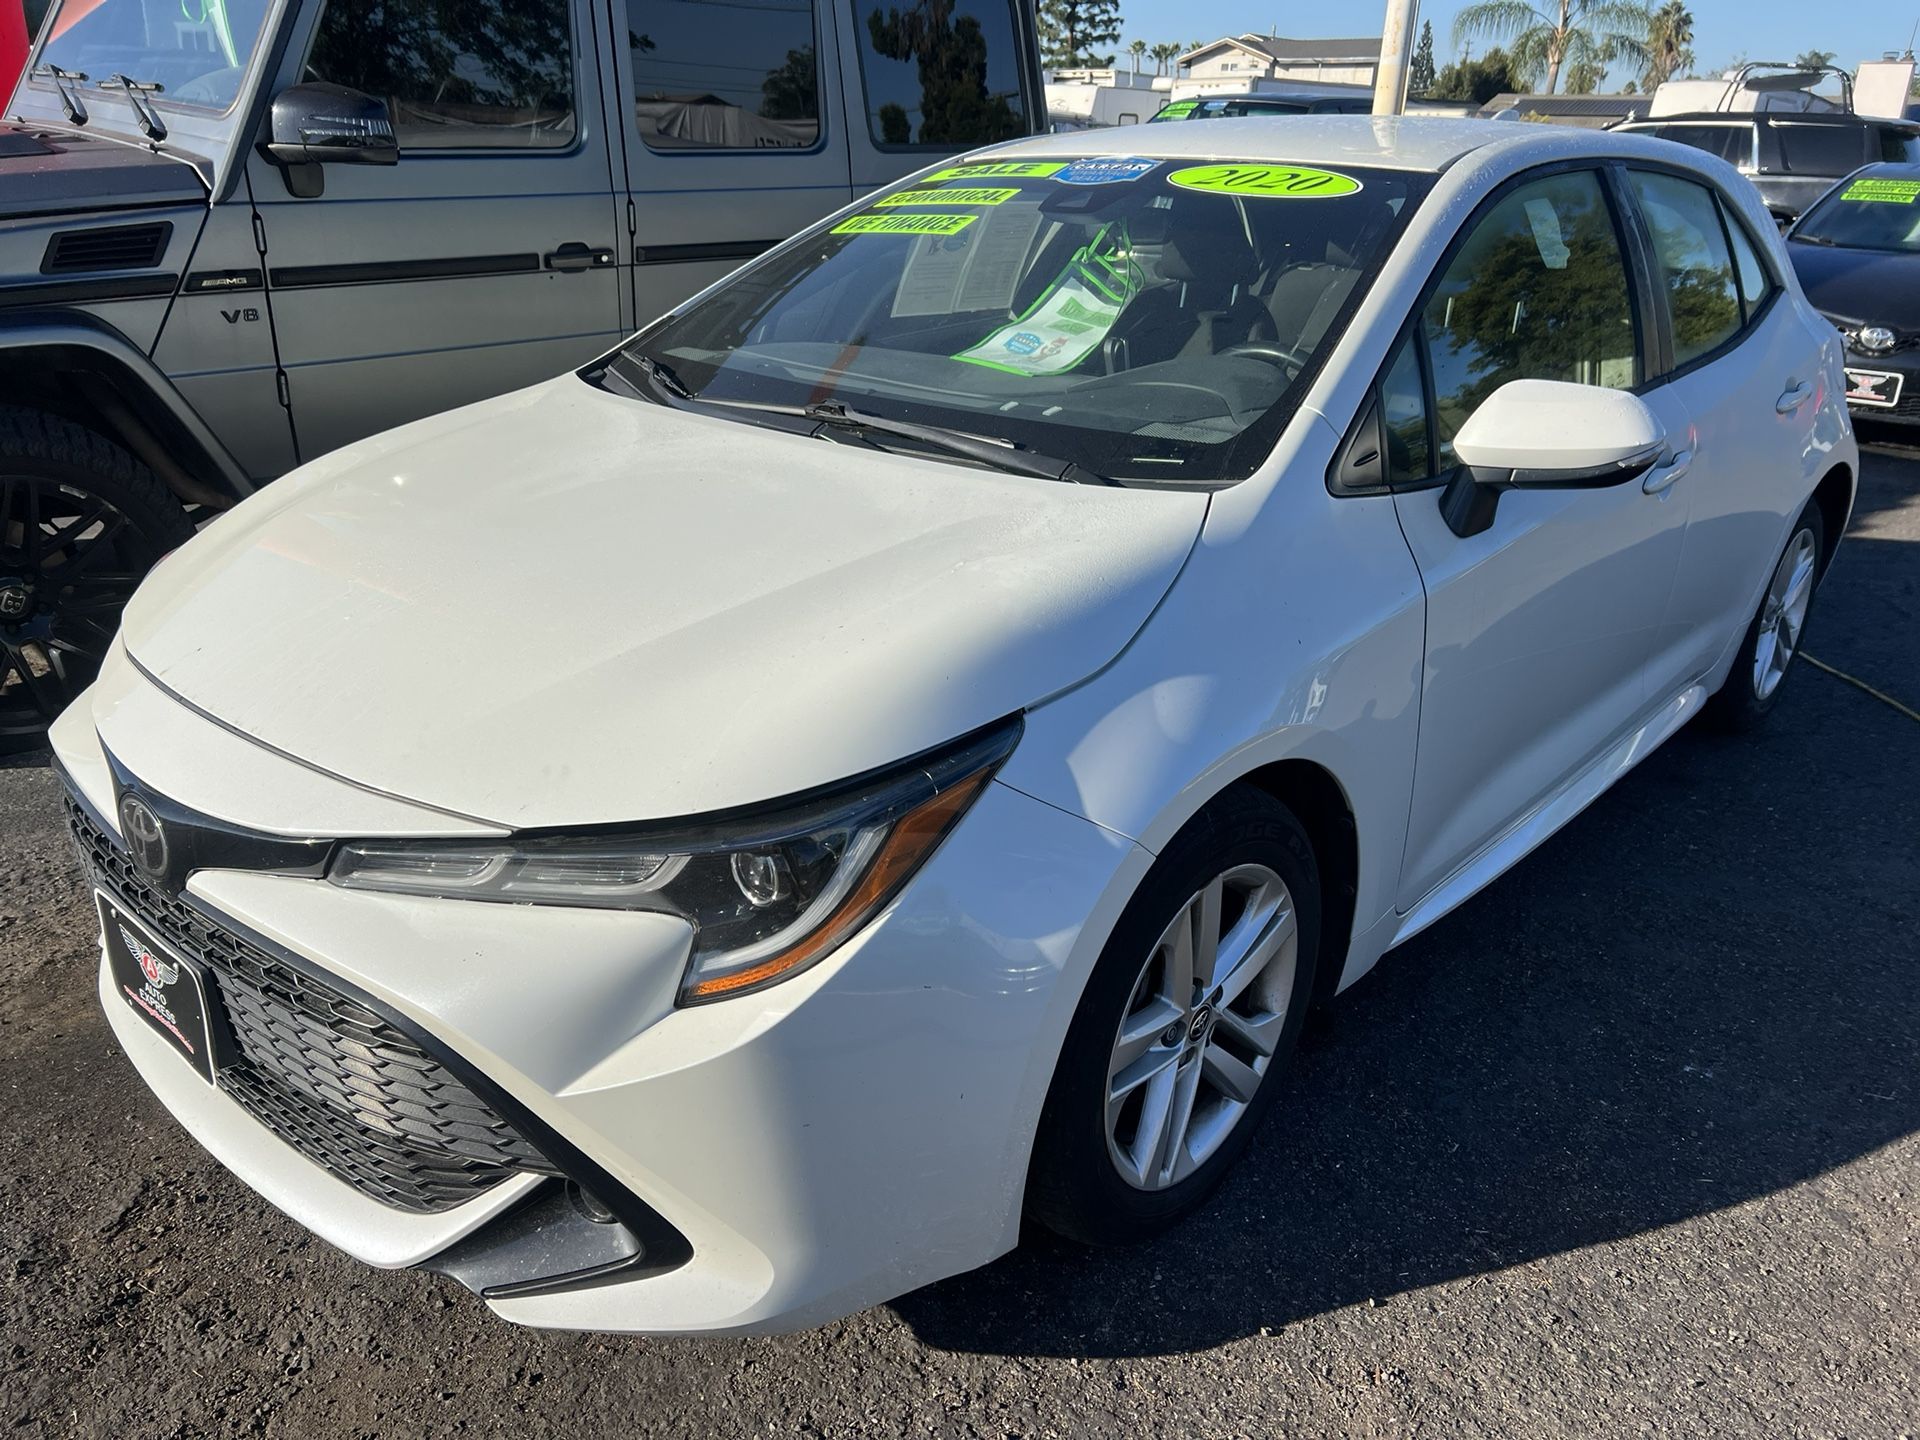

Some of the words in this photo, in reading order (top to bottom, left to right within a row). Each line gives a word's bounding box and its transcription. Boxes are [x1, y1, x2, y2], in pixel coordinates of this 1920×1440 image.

[948, 164, 1034, 177] SALE
[1189, 169, 1334, 192] 2020
[840, 216, 874, 231] WE
[872, 216, 963, 231] FINANCE
[217, 277, 248, 286] AMG
[220, 308, 259, 324] V8
[145, 982, 167, 1005] AUTO
[138, 987, 176, 1025] EXPRESS
